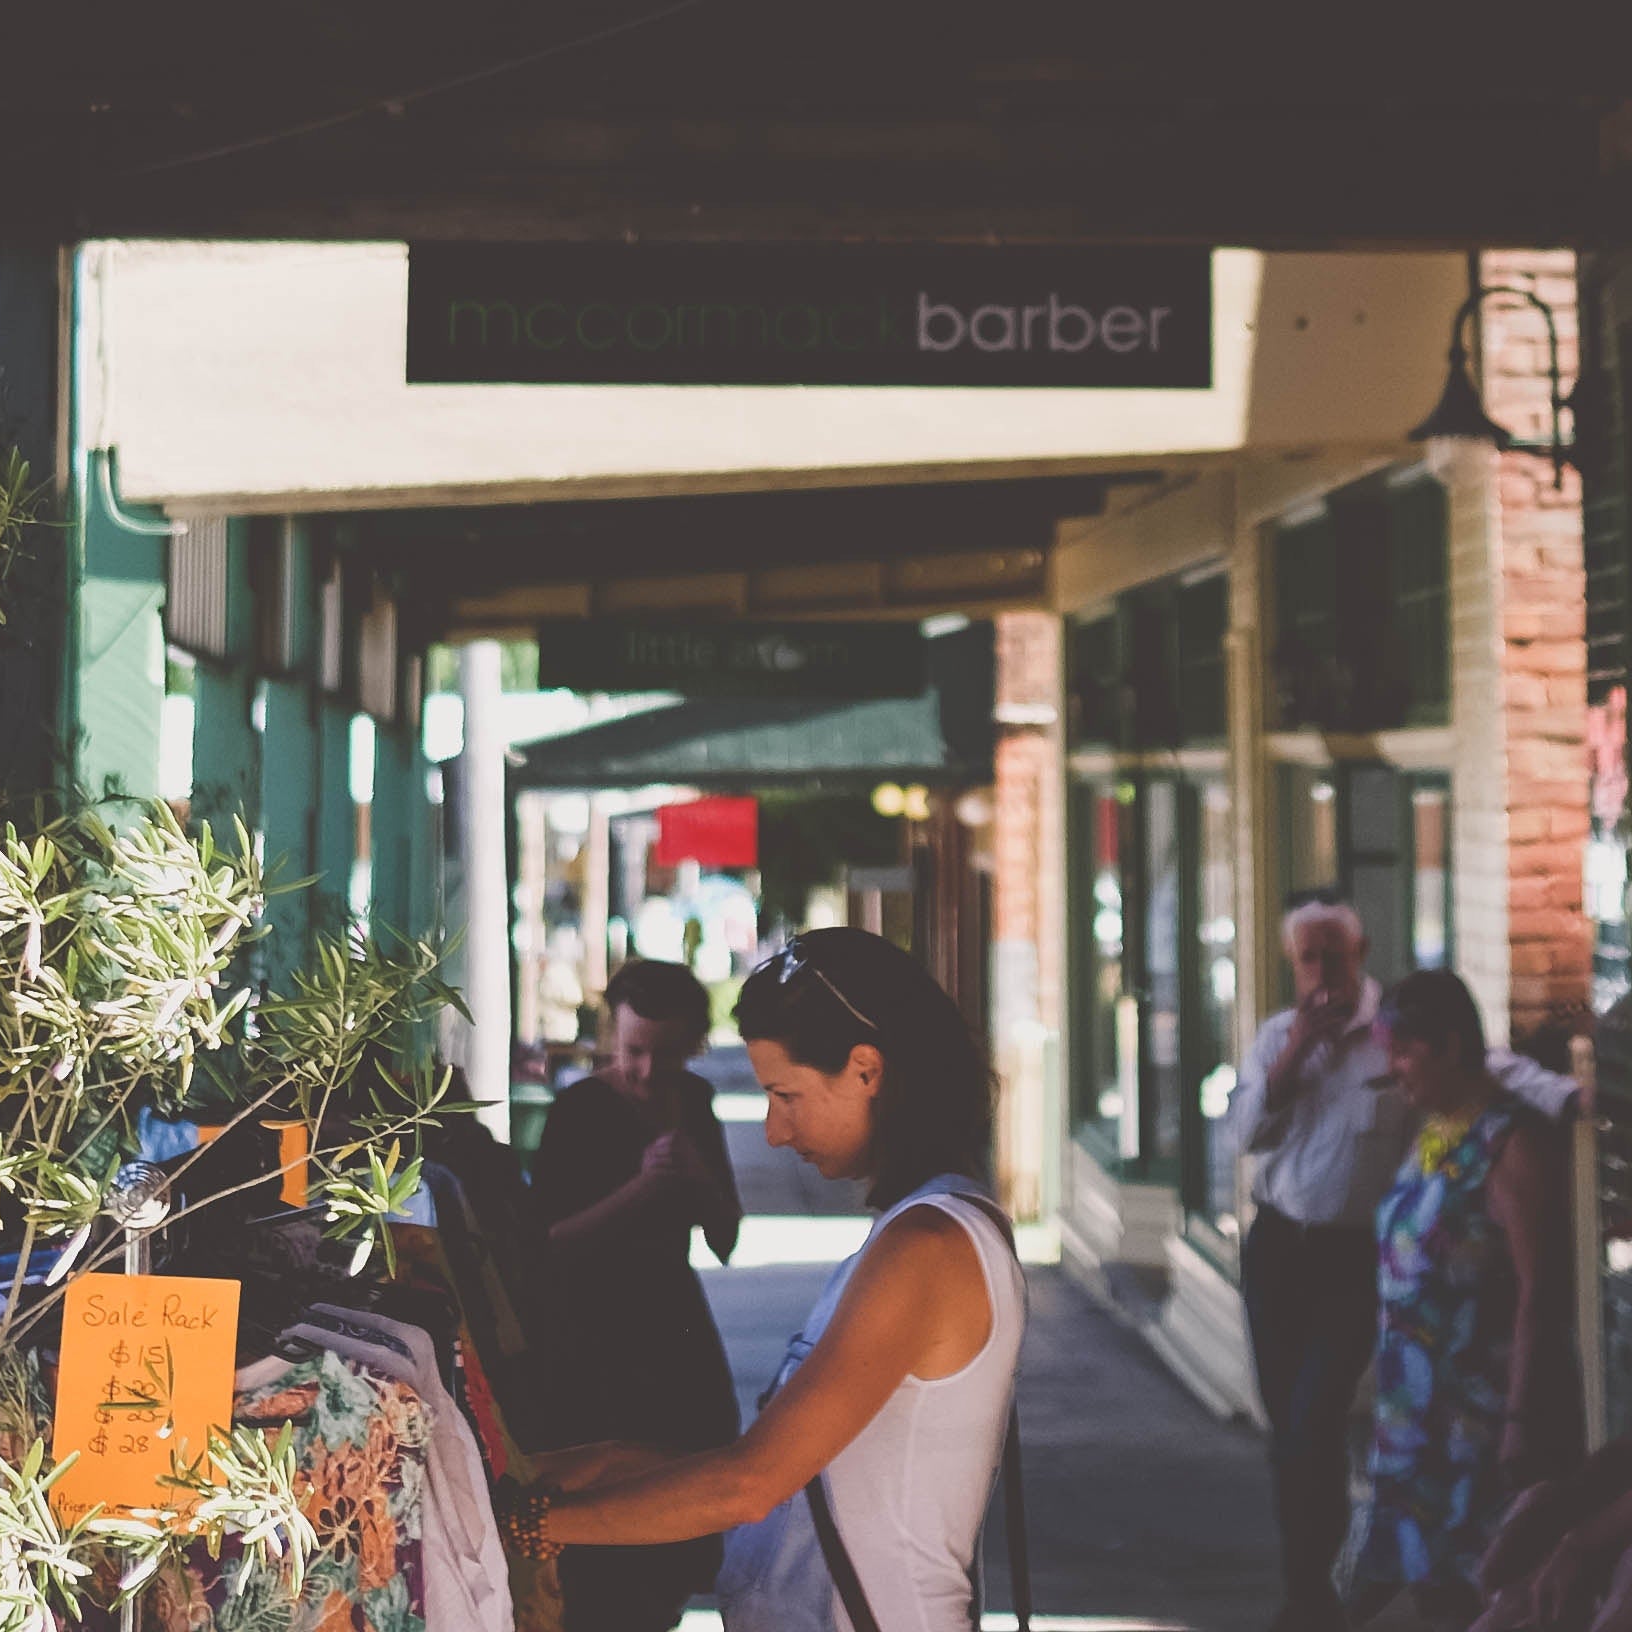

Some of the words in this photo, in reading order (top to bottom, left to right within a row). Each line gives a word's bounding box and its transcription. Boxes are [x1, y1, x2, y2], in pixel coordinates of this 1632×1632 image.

[918, 292, 1169, 352] barber
[82, 1294, 148, 1328] Sale
[162, 1294, 217, 1330] Rack
